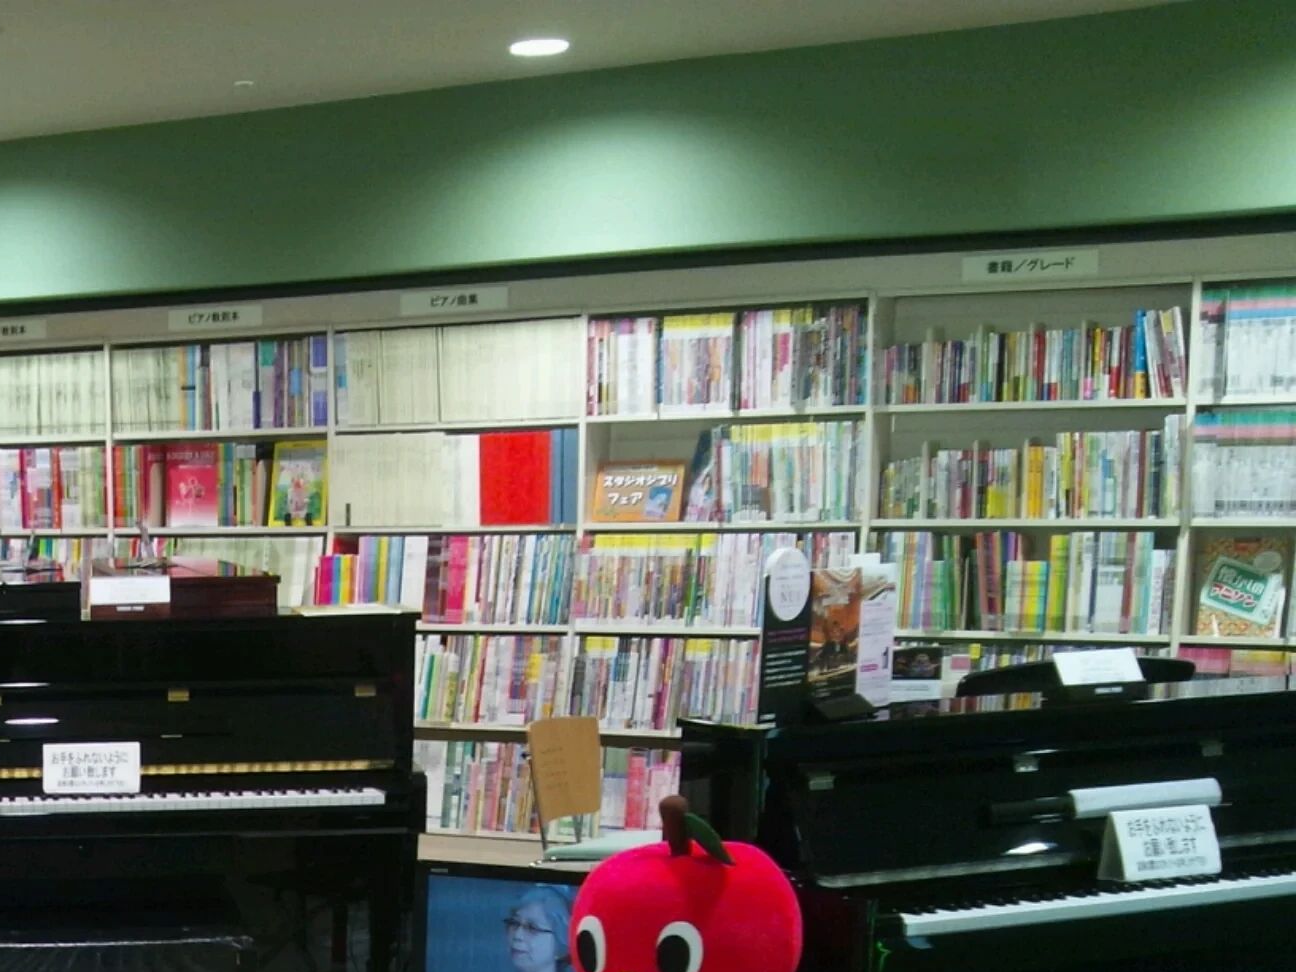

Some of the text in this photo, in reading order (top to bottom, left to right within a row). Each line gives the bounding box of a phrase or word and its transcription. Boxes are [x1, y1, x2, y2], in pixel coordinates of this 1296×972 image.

[602, 474, 679, 489] スタジオジブリ
[607, 491, 644, 506] フェア
[1209, 583, 1257, 609] アニソン
